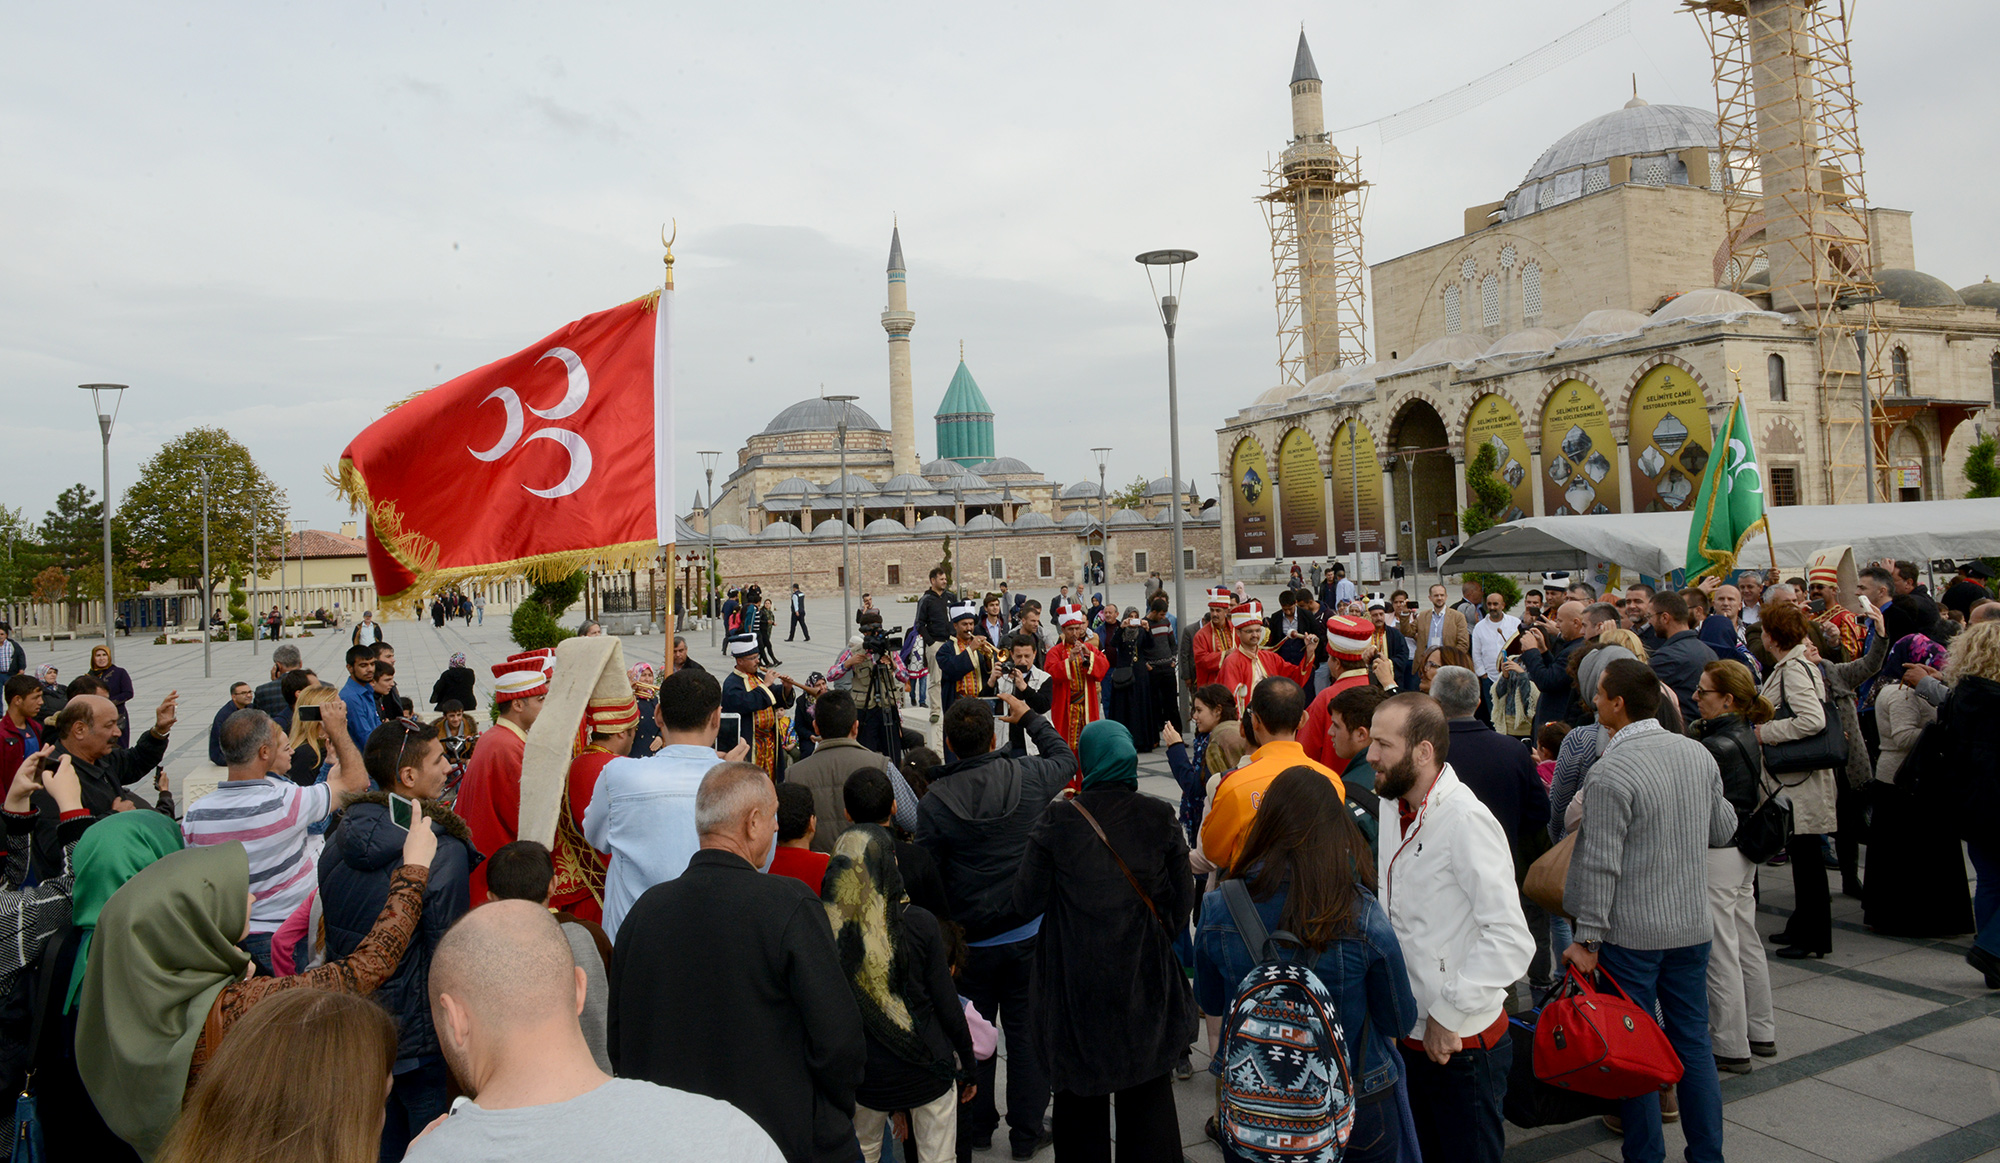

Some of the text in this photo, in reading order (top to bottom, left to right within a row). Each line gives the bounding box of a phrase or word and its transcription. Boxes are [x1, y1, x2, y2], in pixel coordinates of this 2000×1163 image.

[1646, 389, 1691, 402] SELİMİYE CAMİİ
[1643, 397, 1696, 410] RESTORASYON ÖNCESİ
